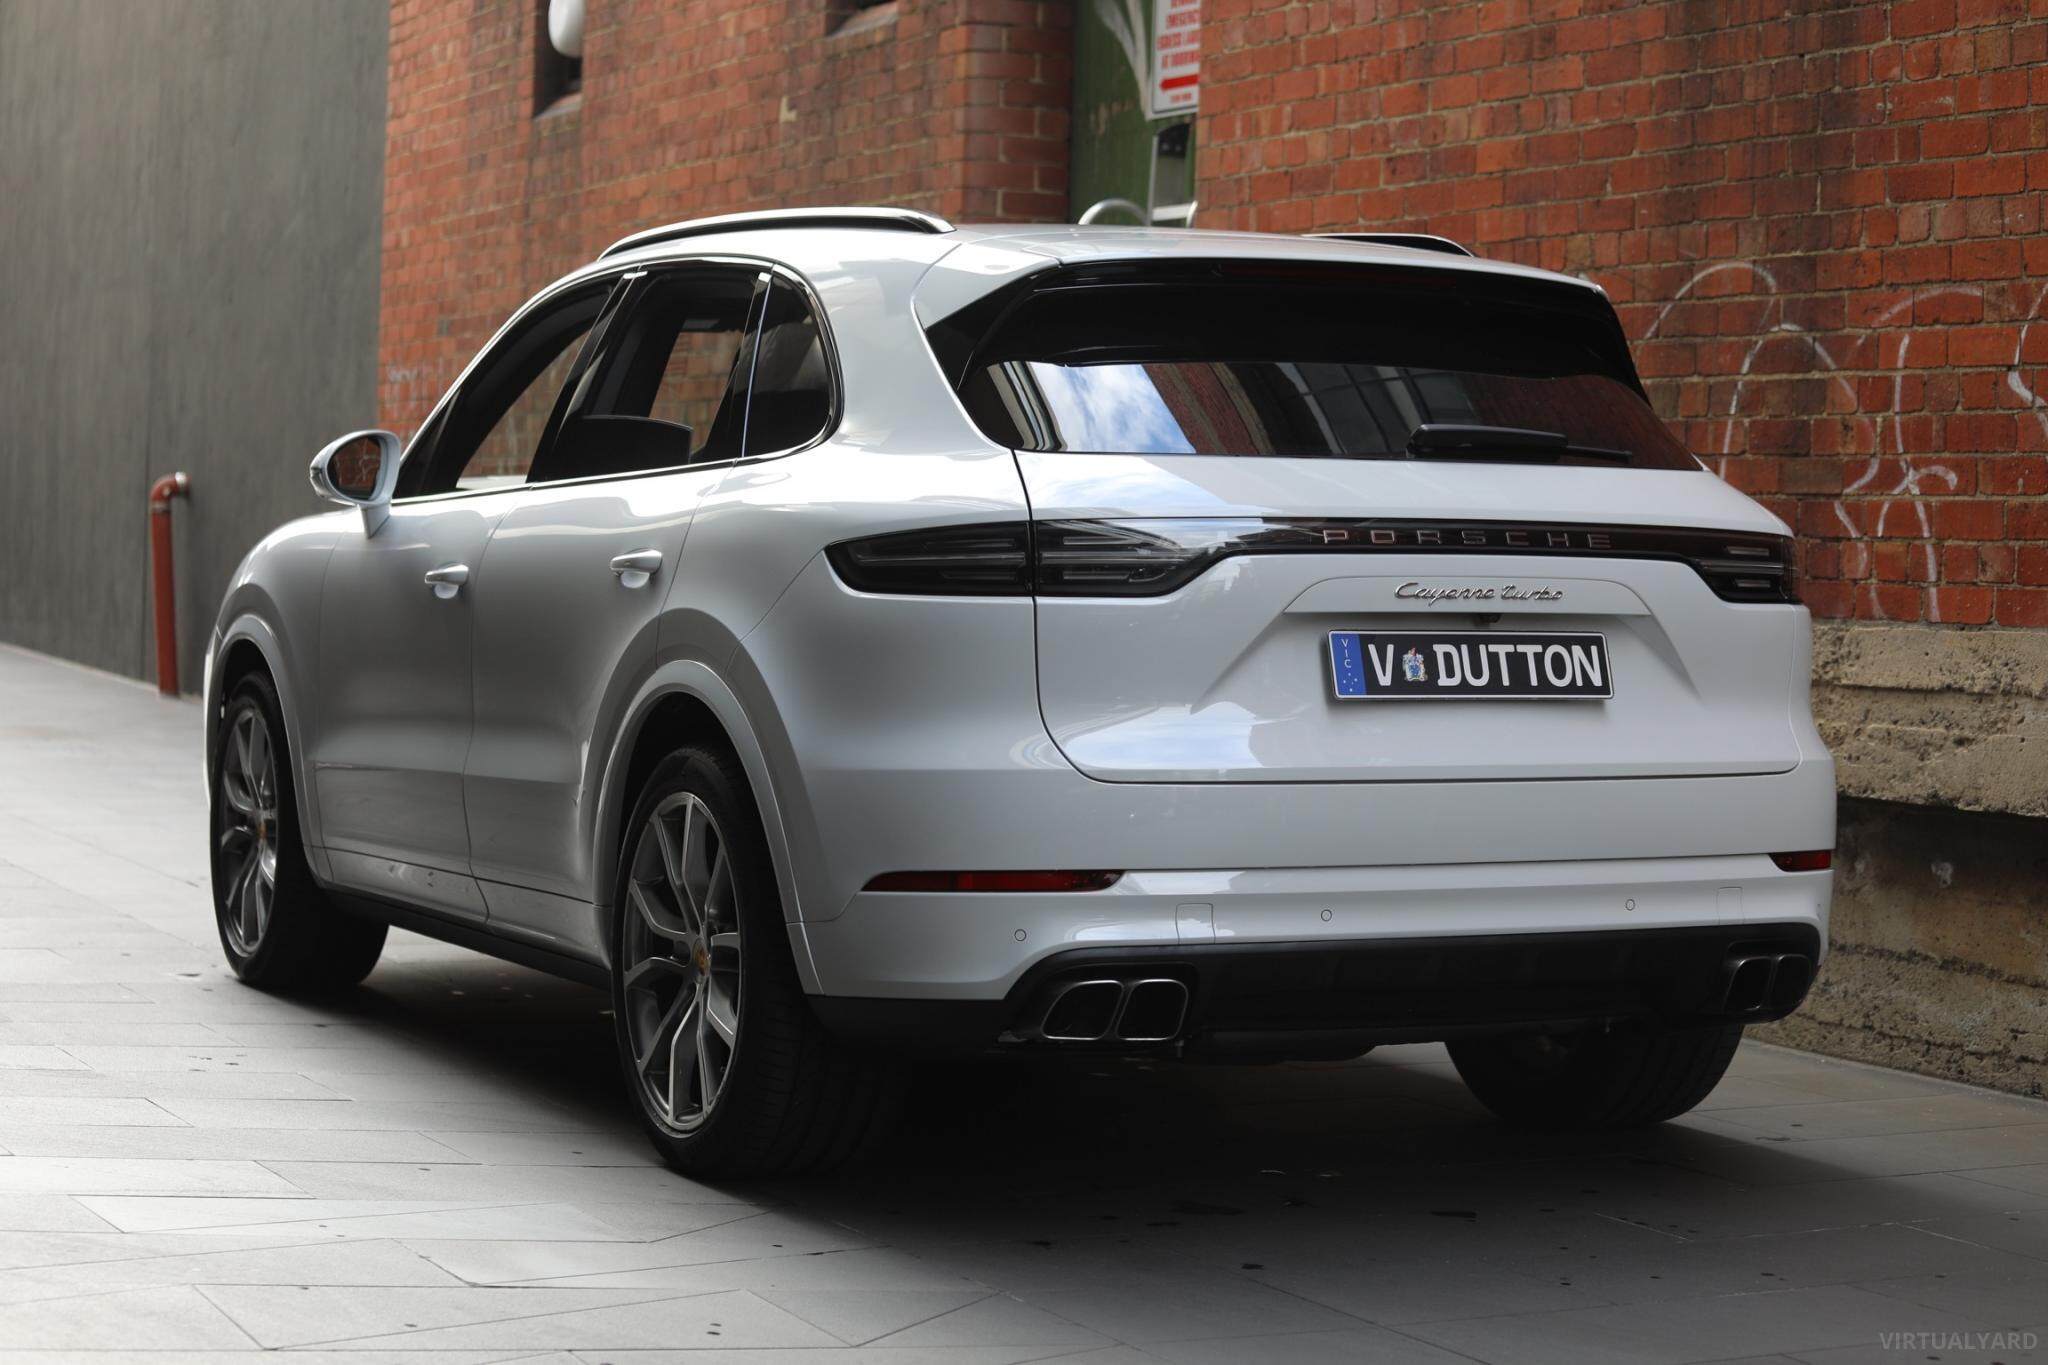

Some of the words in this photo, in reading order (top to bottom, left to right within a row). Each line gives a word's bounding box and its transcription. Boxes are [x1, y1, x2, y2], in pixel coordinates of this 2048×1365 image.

[1322, 529, 1611, 549] PORSCHE
[1394, 582, 1495, 607] Cayenne
[1340, 638, 1353, 669] VIC
[1367, 644, 1395, 687] V
[1432, 644, 1604, 688] DUTTON
